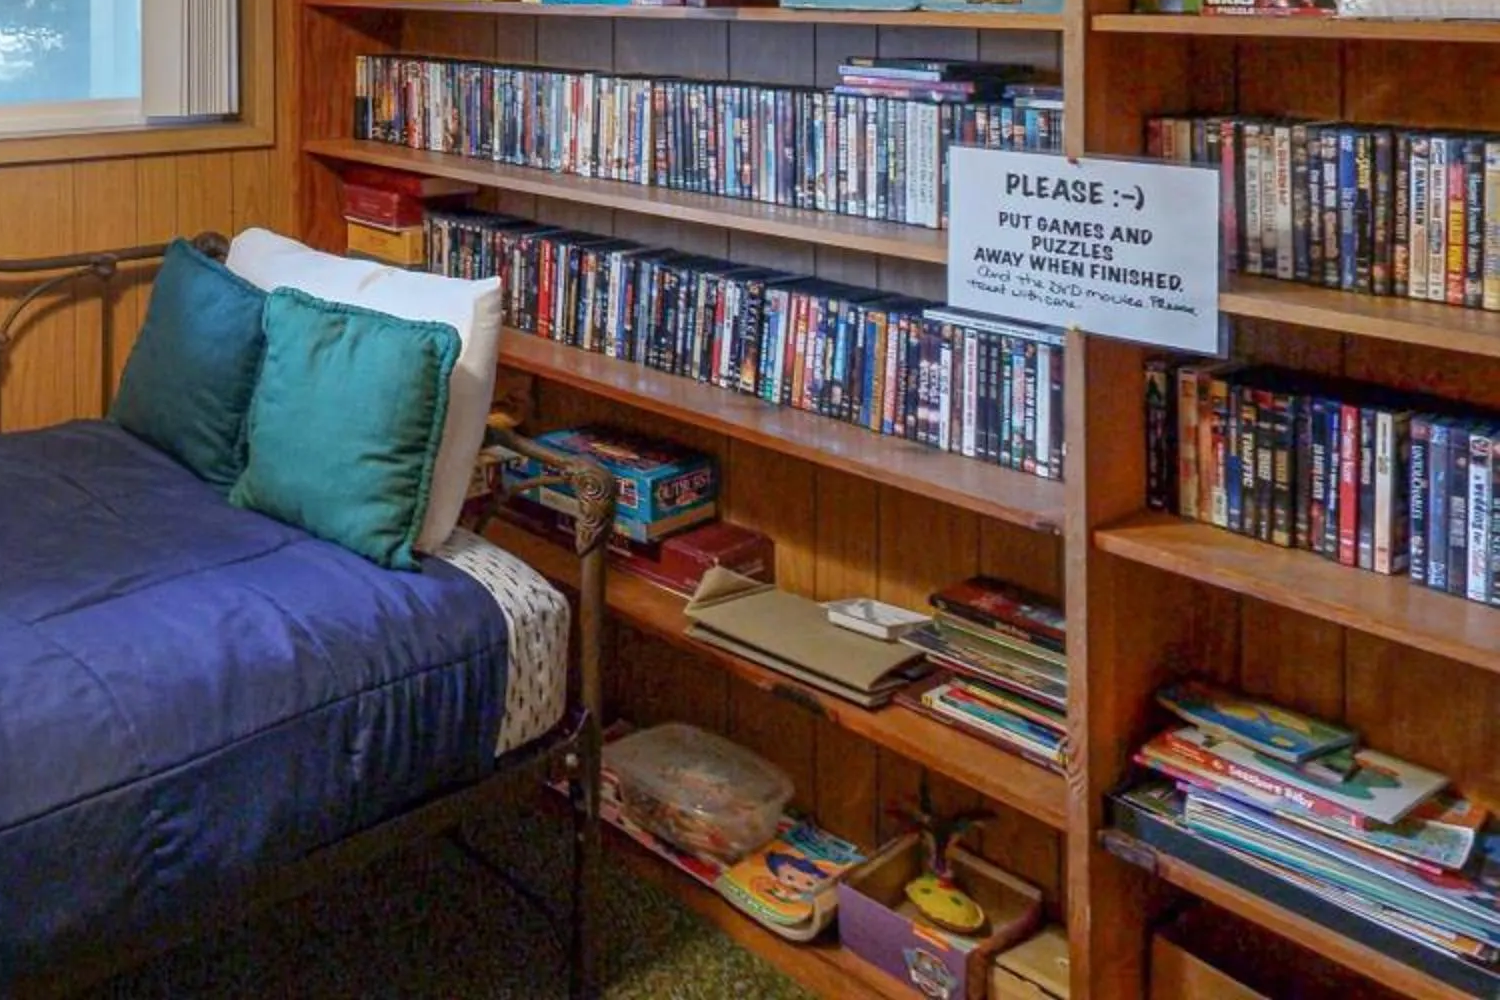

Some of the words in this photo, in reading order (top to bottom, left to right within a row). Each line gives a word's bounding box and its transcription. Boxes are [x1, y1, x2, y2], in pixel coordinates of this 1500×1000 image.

[1005, 172, 1104, 205] PLEASE
[999, 211, 1032, 231] PUT
[1037, 216, 1105, 240] GAMES
[1110, 225, 1153, 246] AND
[1031, 235, 1114, 261] PUZZLES
[973, 247, 1024, 268] AWAY
[1030, 254, 1085, 278] WHEN
[1090, 263, 1185, 293] FINISHED.
[1019, 271, 1046, 291] the
[1048, 280, 1083, 298] DVD
